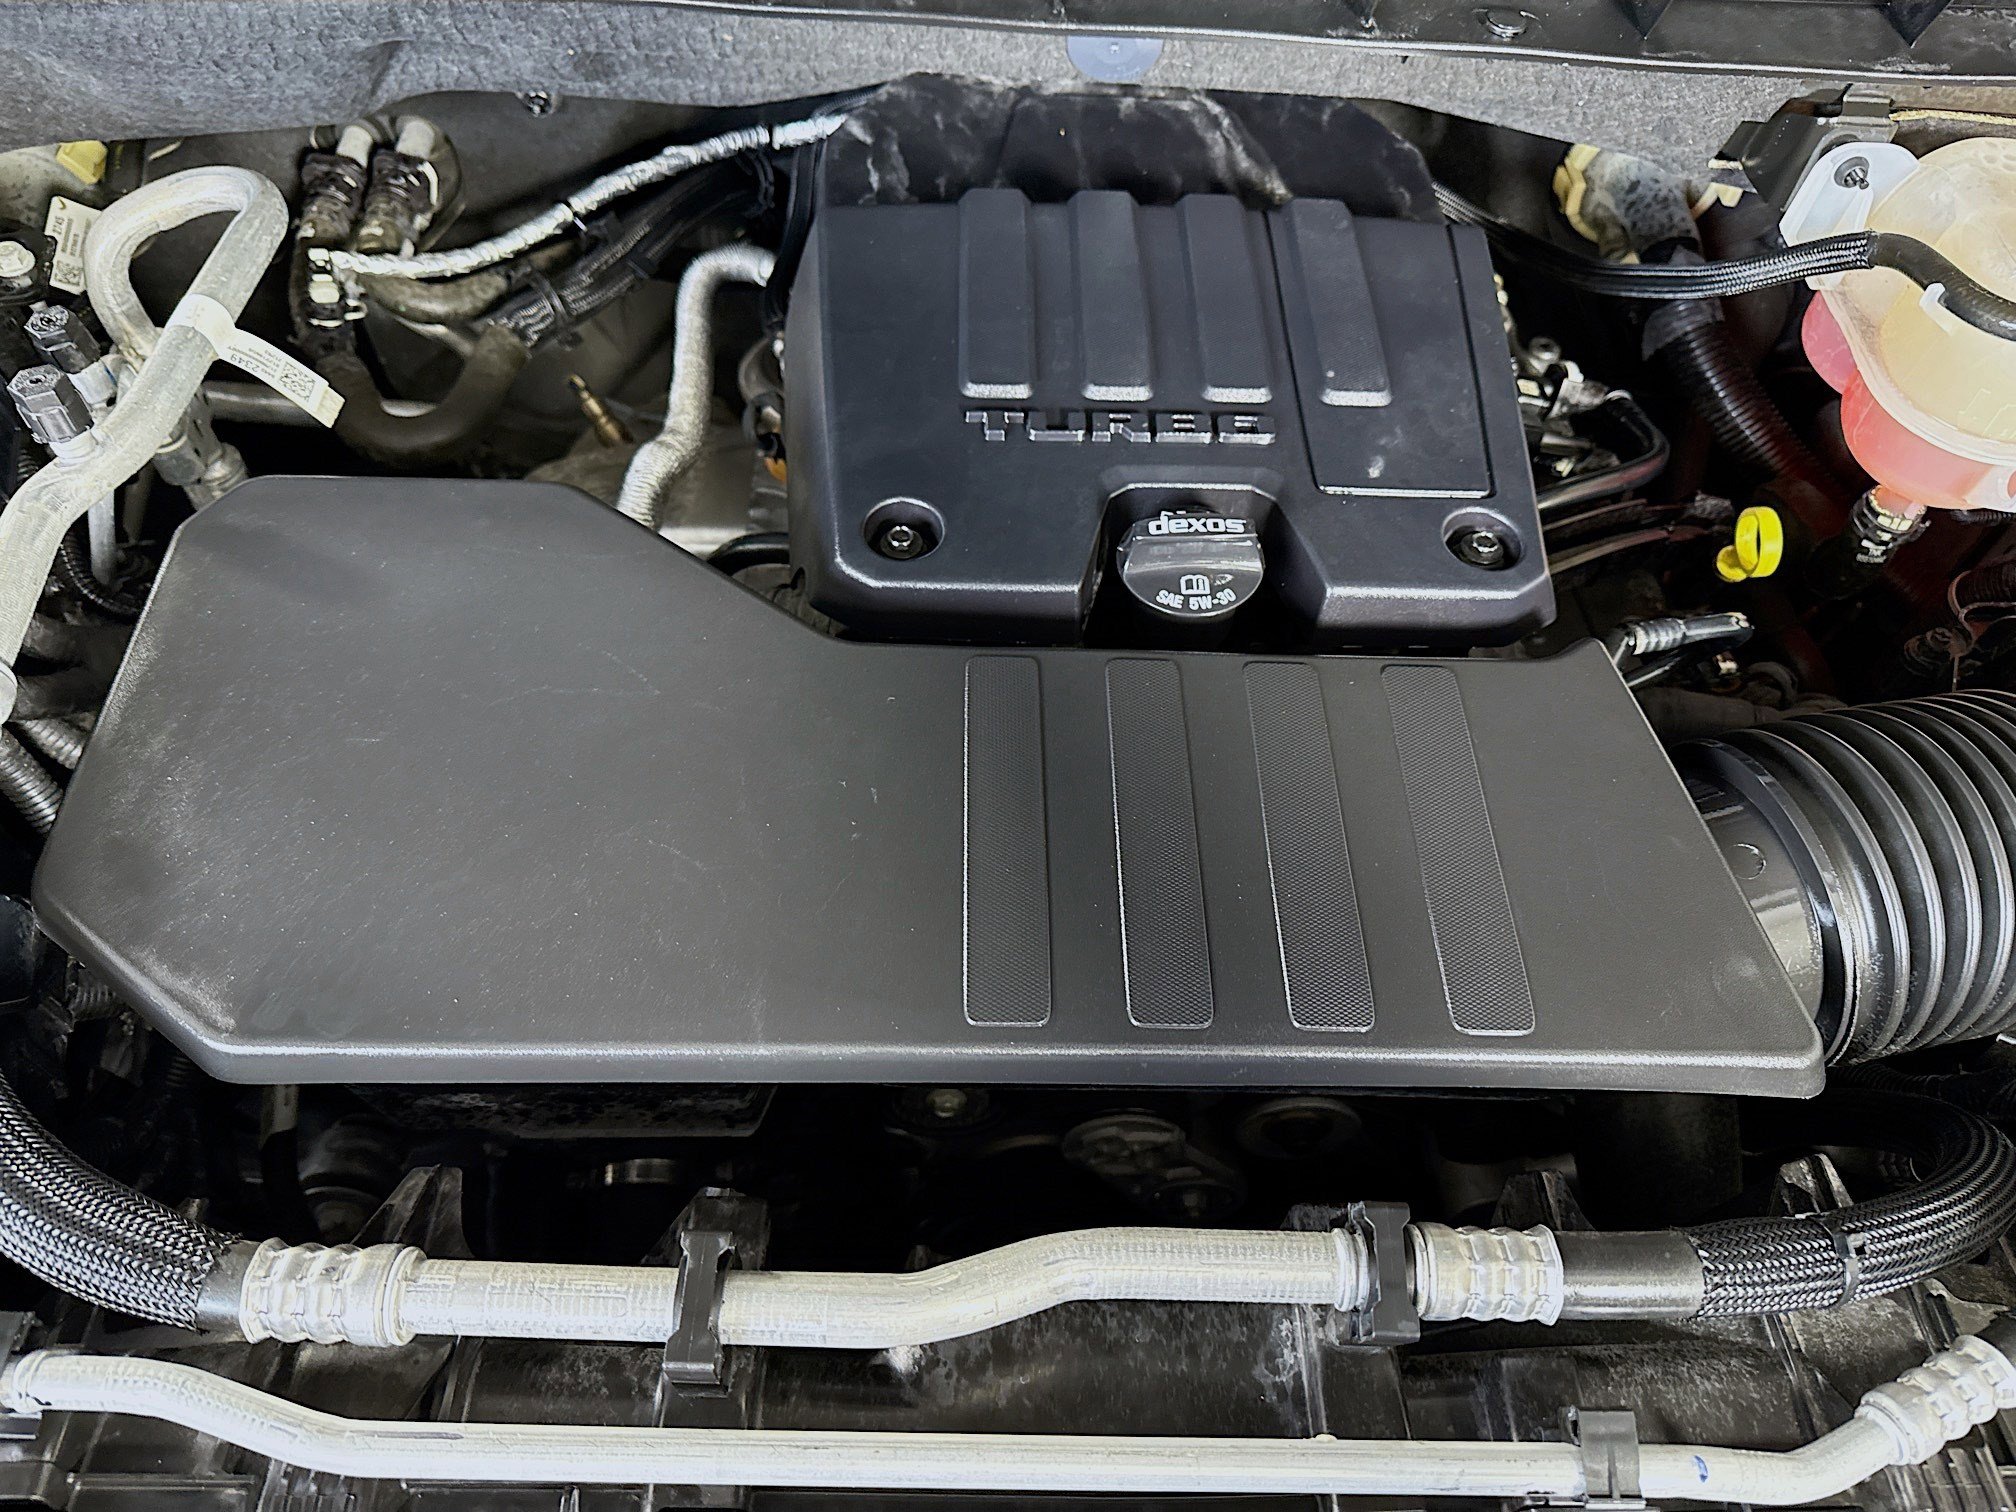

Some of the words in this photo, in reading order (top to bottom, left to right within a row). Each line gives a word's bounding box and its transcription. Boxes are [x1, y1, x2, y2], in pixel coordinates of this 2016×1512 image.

[230, 353, 260, 373] 2349
[965, 411, 1276, 444] TURBO
[1148, 511, 1246, 535] dexos
[1156, 590, 1184, 609] SAE
[1189, 588, 1237, 610] 5W-30
